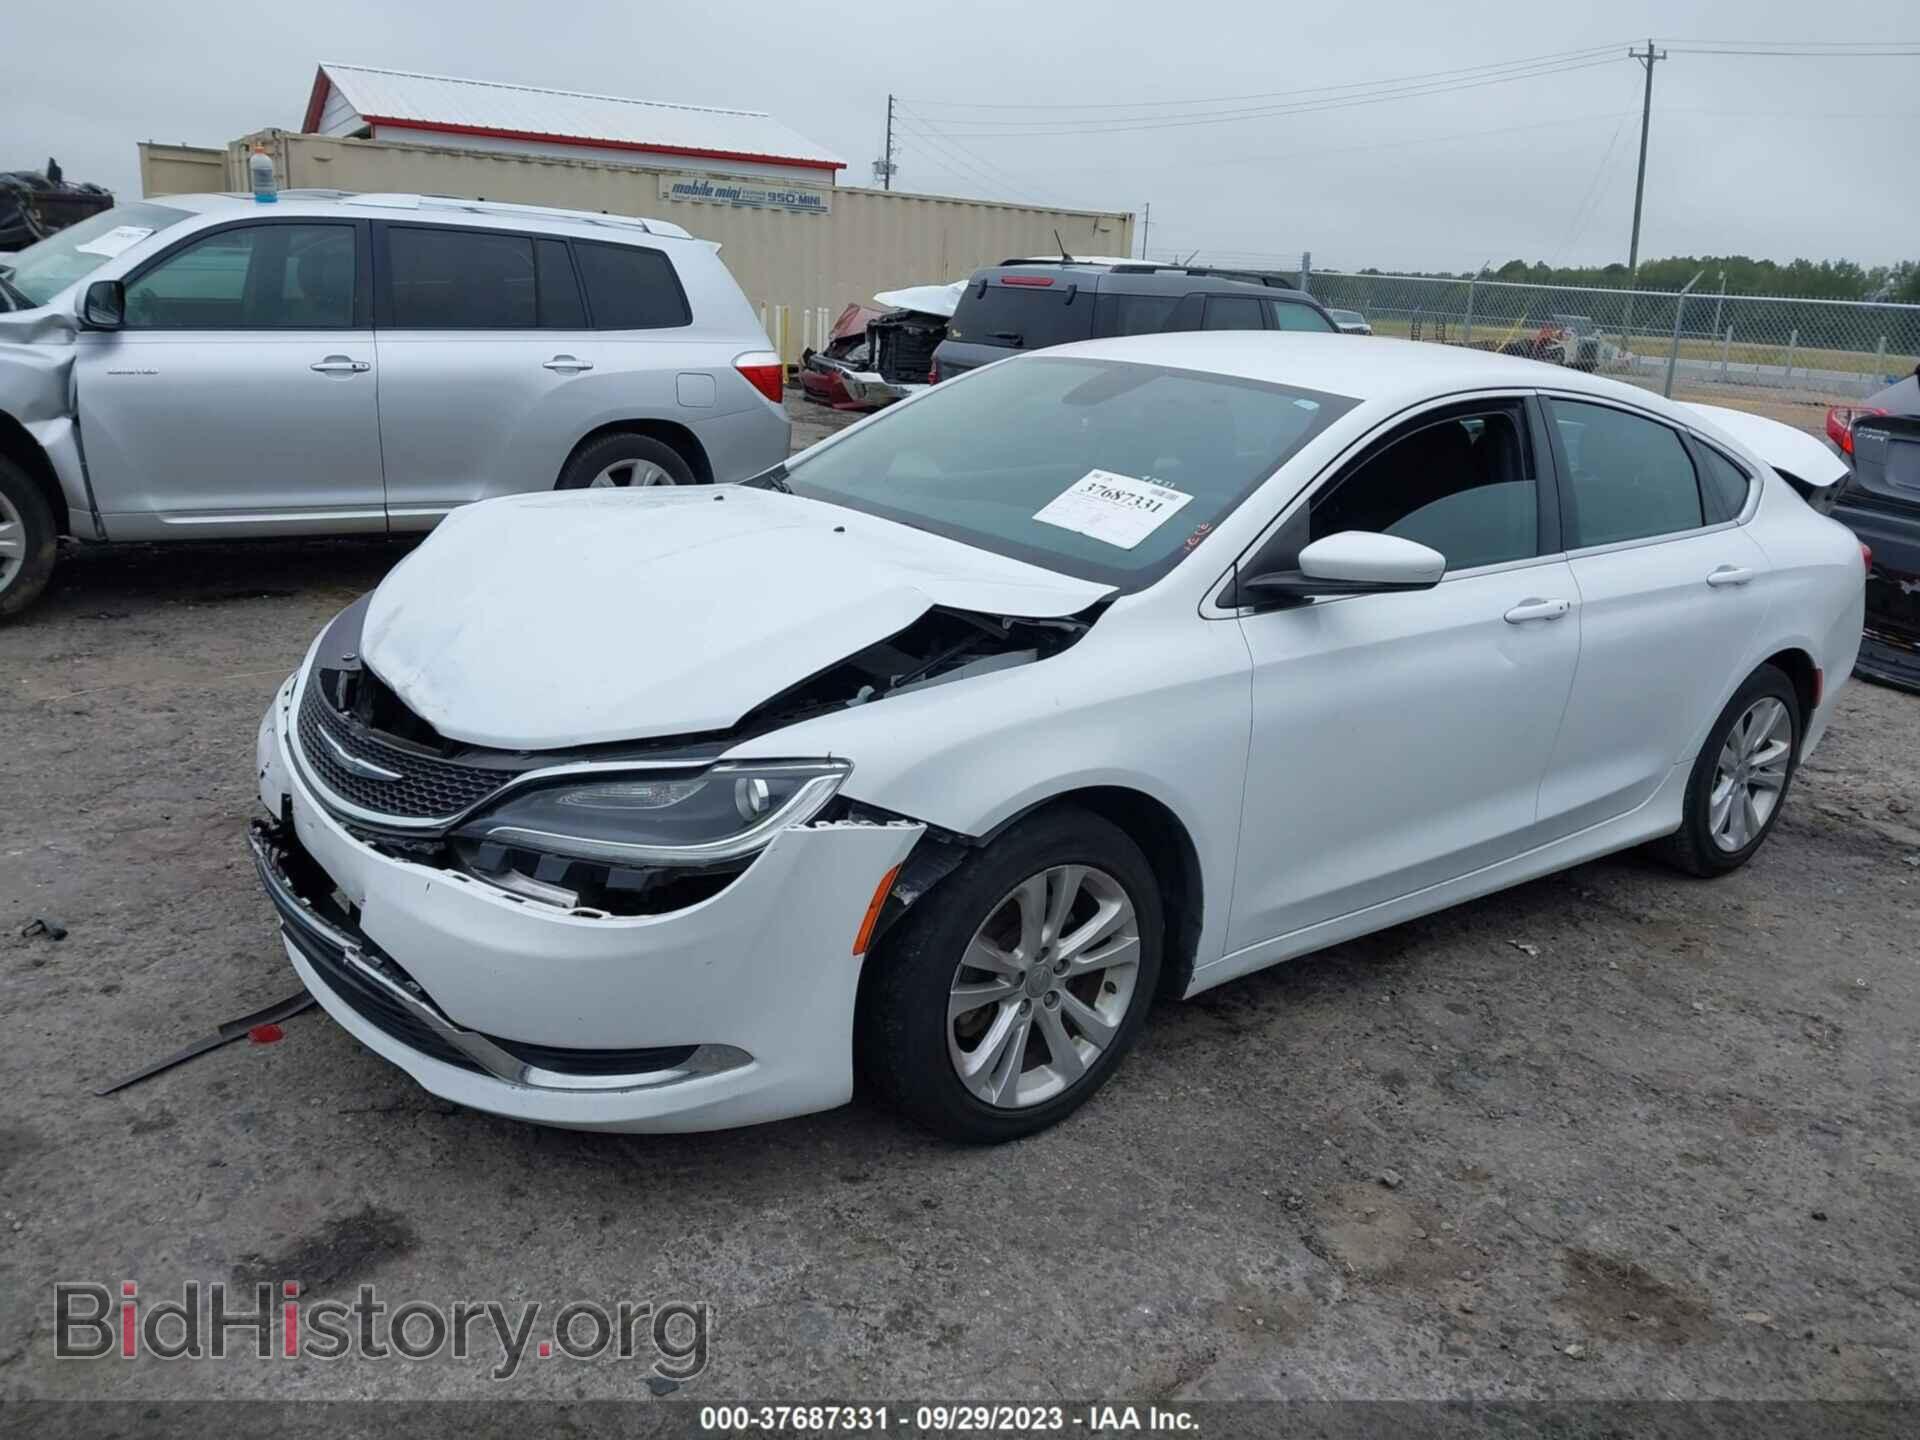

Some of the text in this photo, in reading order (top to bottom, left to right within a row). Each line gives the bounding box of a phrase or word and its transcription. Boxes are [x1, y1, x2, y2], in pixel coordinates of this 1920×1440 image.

[672, 180, 713, 197] mobile
[715, 186, 742, 200] mini
[1080, 483, 1163, 512] 37687331
